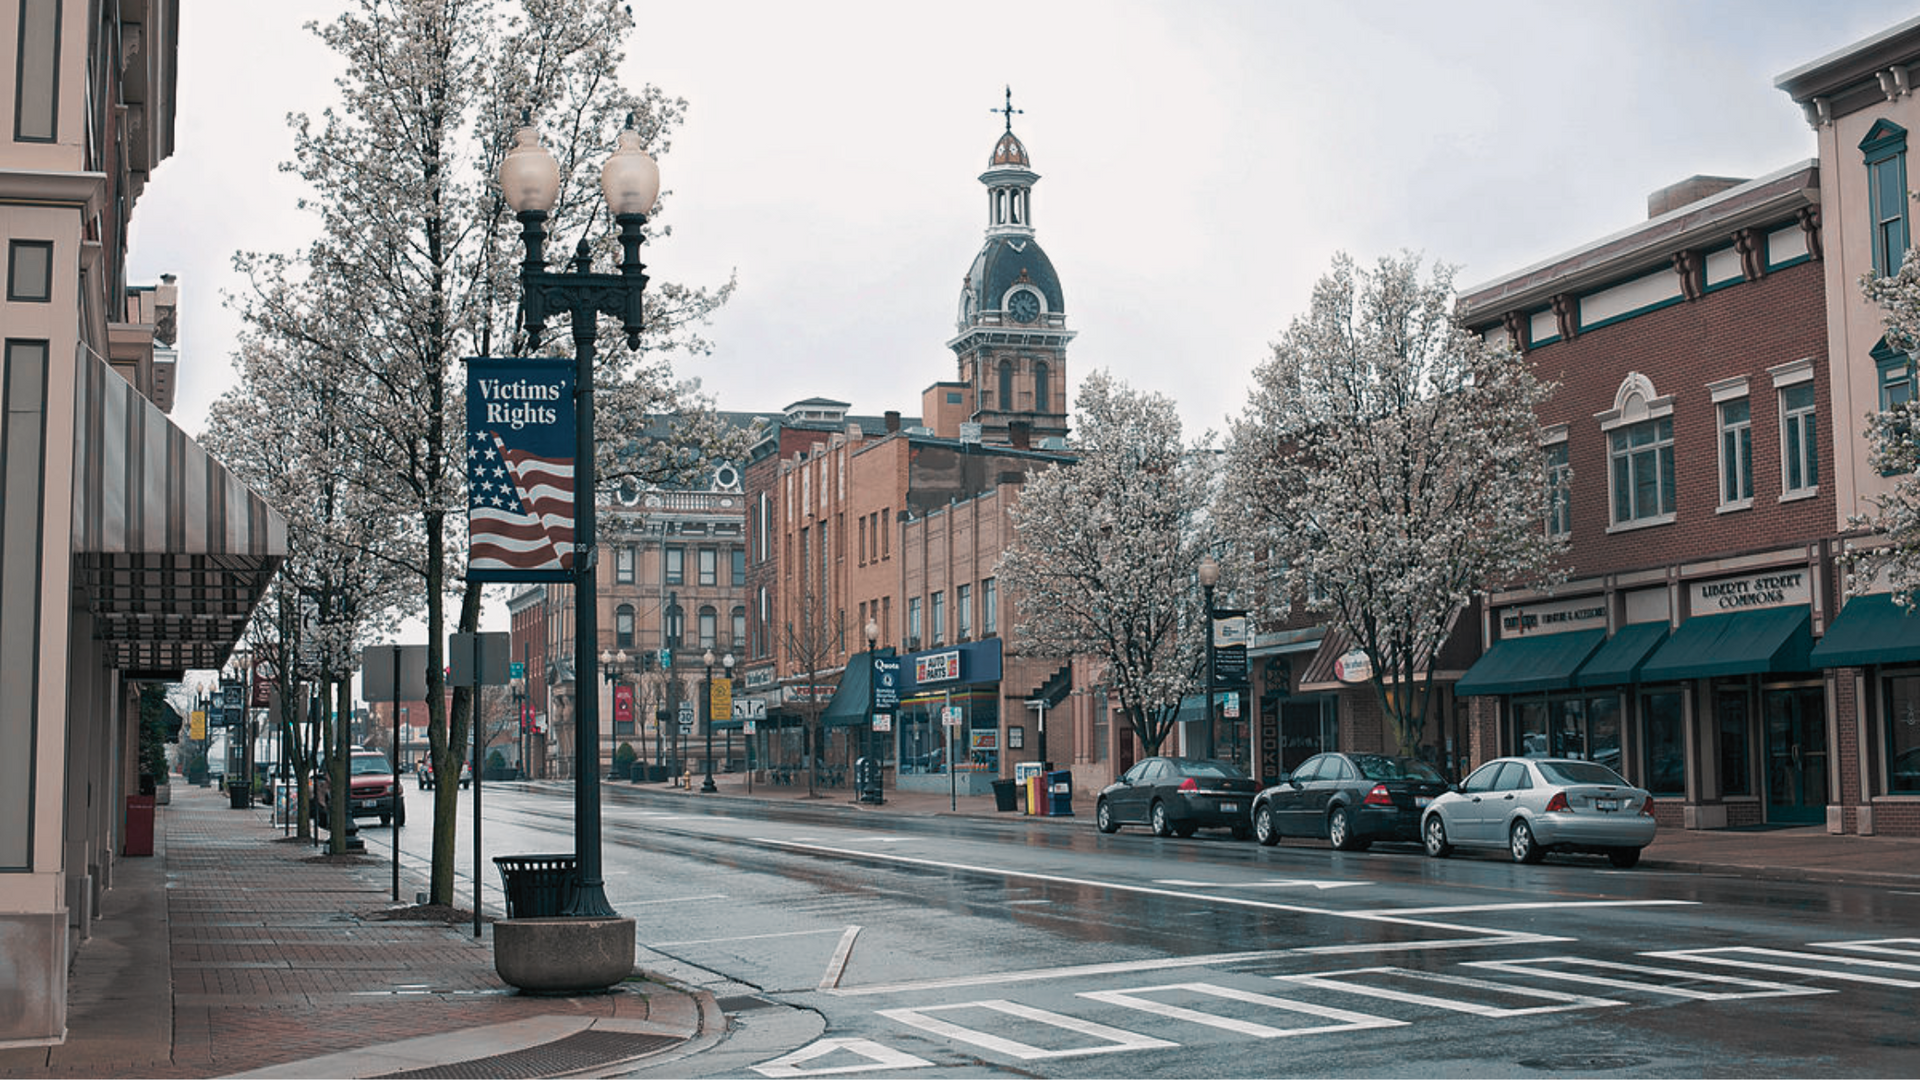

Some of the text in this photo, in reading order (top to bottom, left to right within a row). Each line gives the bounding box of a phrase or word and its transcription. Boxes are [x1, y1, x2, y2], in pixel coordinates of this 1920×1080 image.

[478, 379, 566, 401] Victims'
[486, 403, 557, 430] Rights
[1702, 573, 1802, 599] LIBERTY STREET
[1719, 589, 1784, 609] COMMONS
[928, 655, 945, 669] AUTO
[926, 667, 946, 680] PARTS
[681, 712, 692, 722] 30
[1263, 715, 1276, 777] BOOKS
